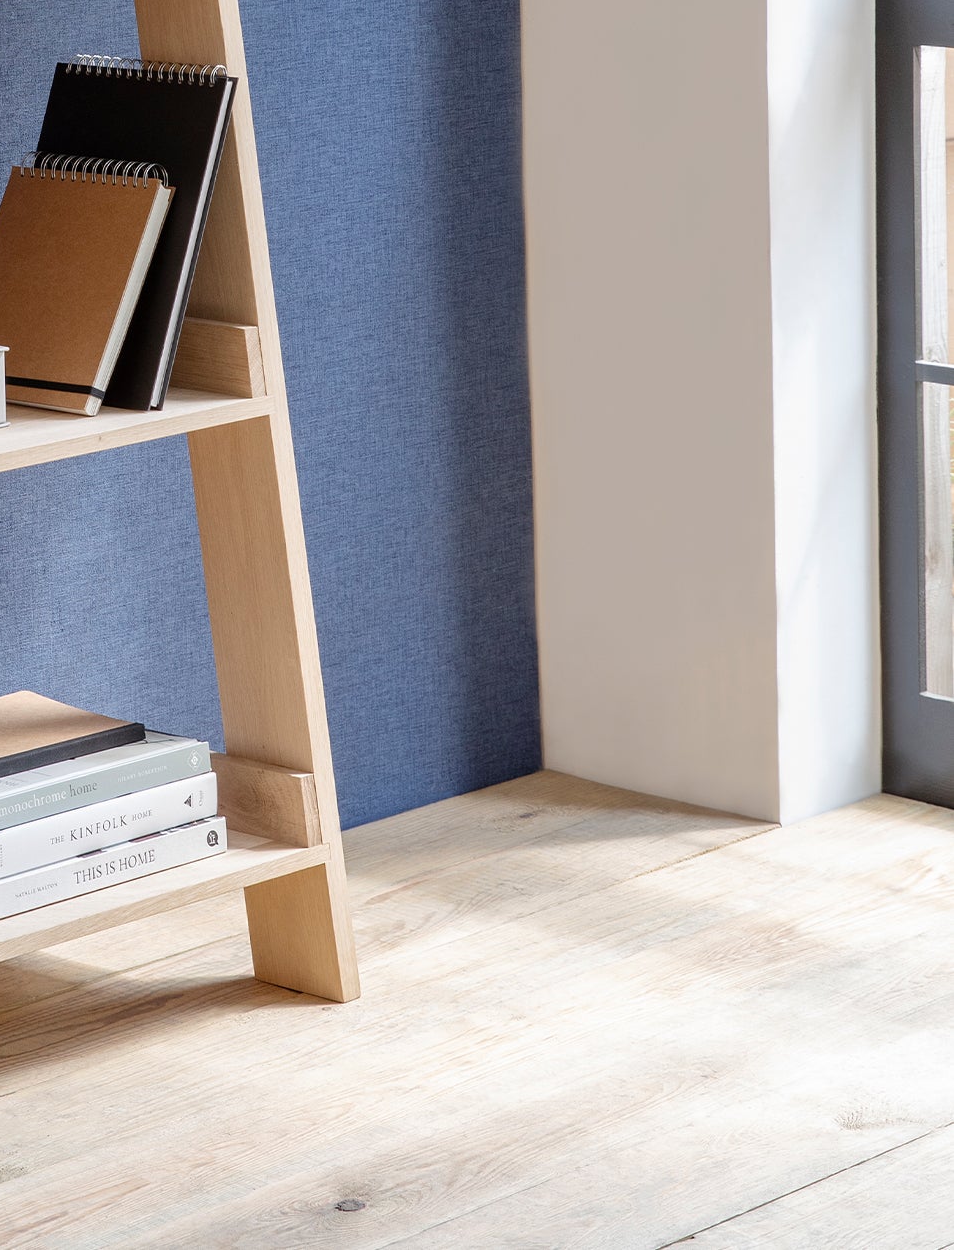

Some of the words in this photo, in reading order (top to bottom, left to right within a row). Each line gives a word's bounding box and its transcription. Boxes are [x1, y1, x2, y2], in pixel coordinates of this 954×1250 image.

[69, 781, 98, 798] home
[50, 835, 65, 846] THE
[70, 814, 128, 841] KINFOLK
[132, 809, 153, 822] HOME
[73, 864, 103, 885] THIS
[105, 861, 116, 877] IS
[119, 849, 156, 872] HOME
